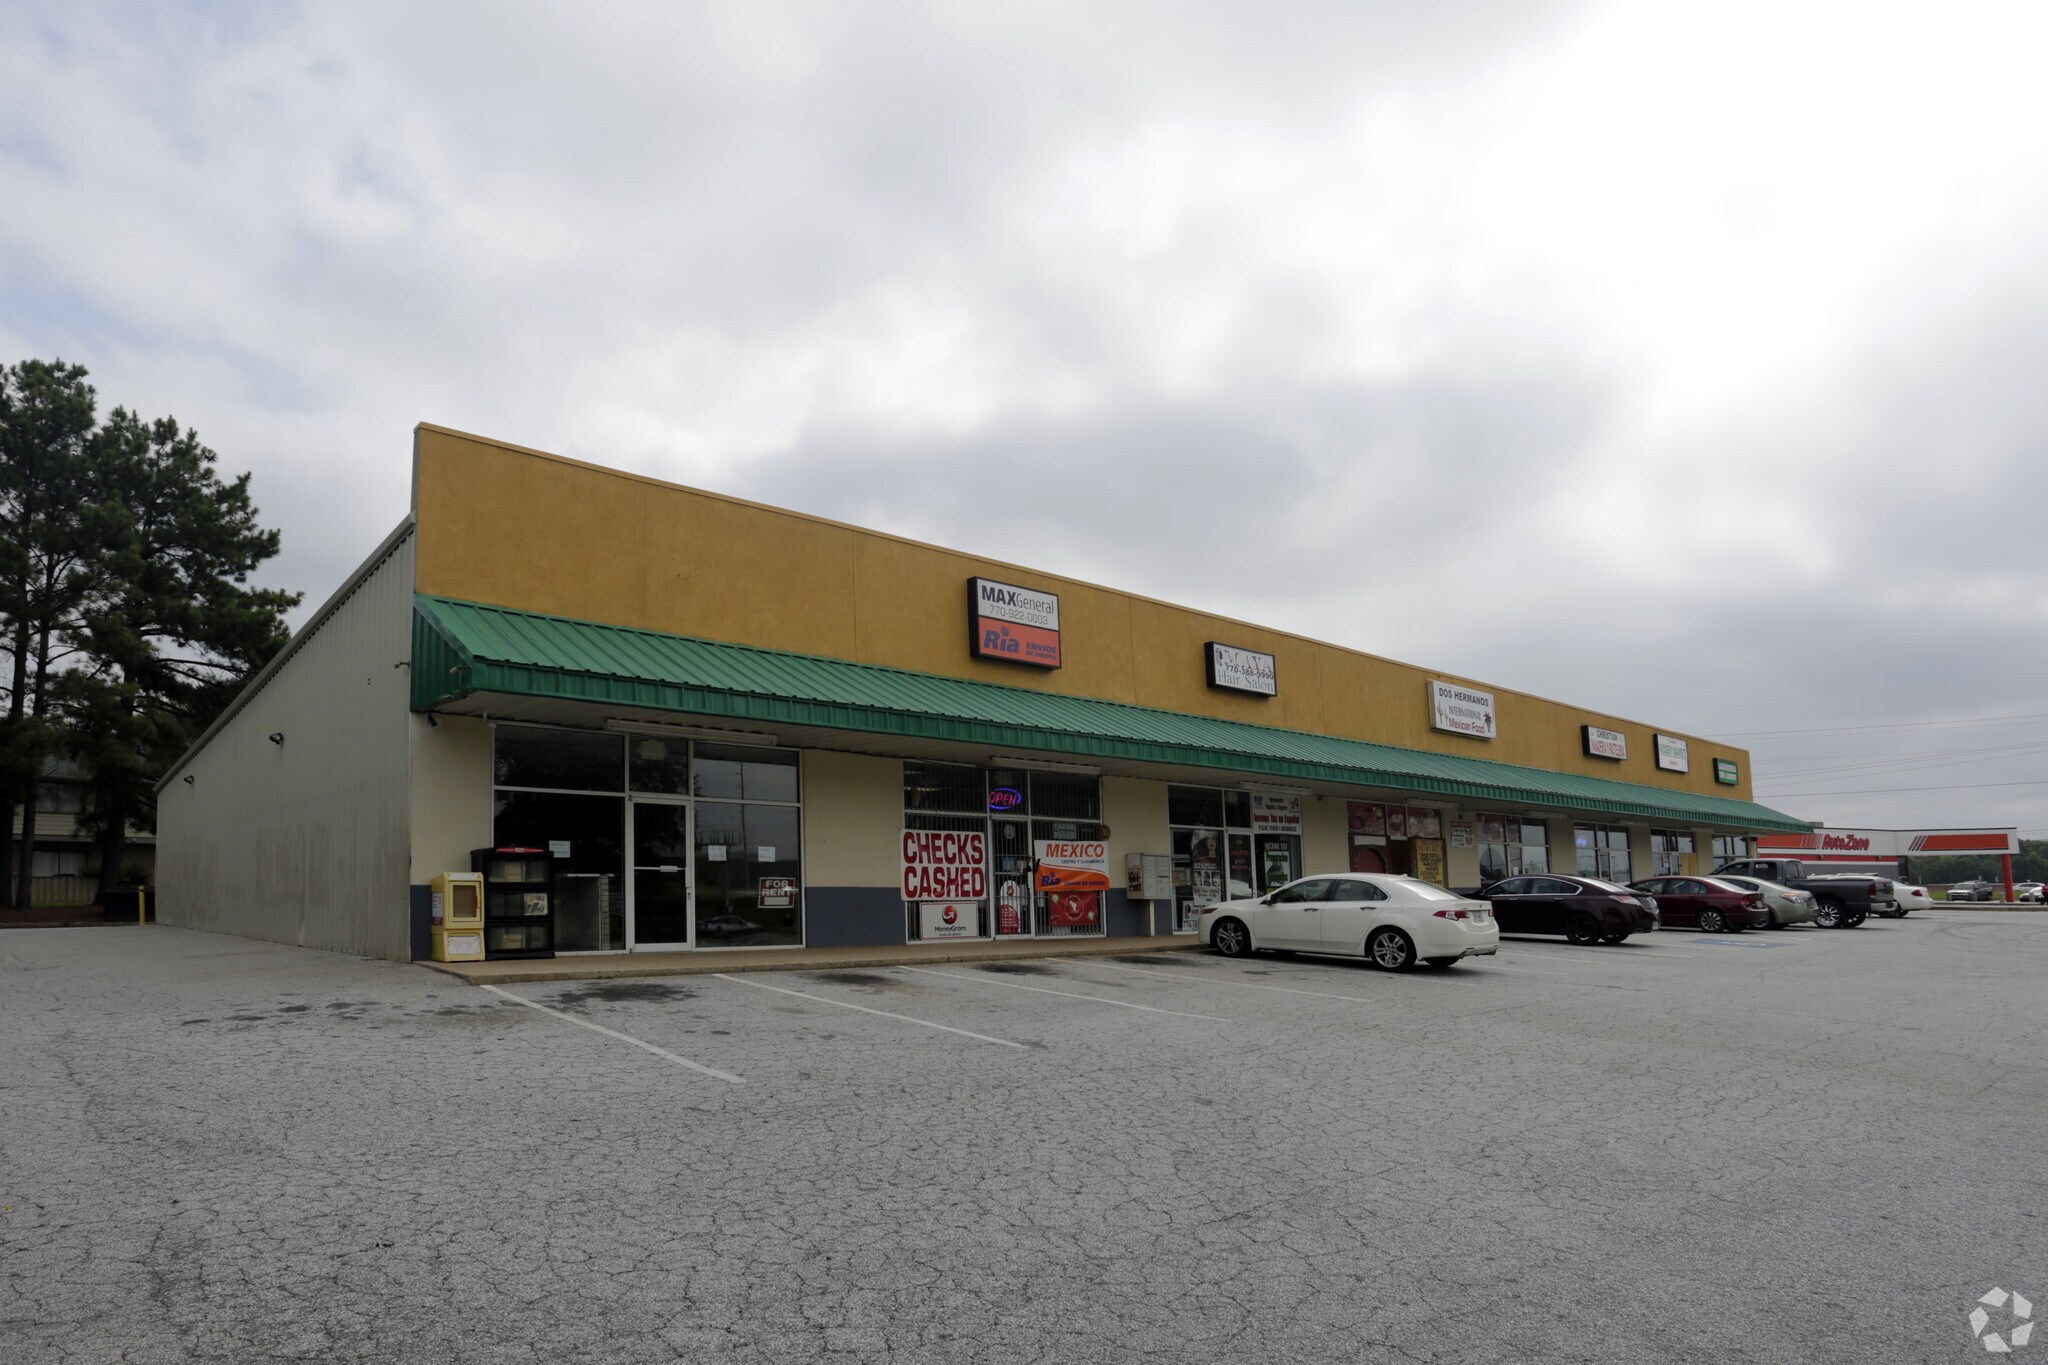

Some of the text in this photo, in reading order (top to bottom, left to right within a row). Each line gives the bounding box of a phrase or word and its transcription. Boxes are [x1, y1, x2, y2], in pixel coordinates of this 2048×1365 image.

[981, 585, 1054, 614] MAXGeneral
[990, 605, 1048, 625] 770-922-0003
[983, 626, 1020, 653] Ria
[1026, 642, 1056, 654] ENVIOS
[1218, 669, 1274, 692] Hair Salon
[1439, 688, 1489, 707] DOS HERMANOS
[1448, 705, 1481, 720] INTERNATIONAL
[1448, 717, 1485, 733] Mexican Food
[1596, 730, 1618, 740] CHRISTIAN
[989, 791, 1017, 805] OPEN
[903, 832, 983, 865] CHECKS
[1822, 834, 1869, 850] AutoZone
[1046, 843, 1104, 858] MEXICO
[766, 880, 789, 888] FOR
[904, 866, 985, 898] CASHED
[1041, 872, 1061, 886] Ria
[762, 888, 791, 896] RENT
[934, 925, 967, 933] MoneyGram
